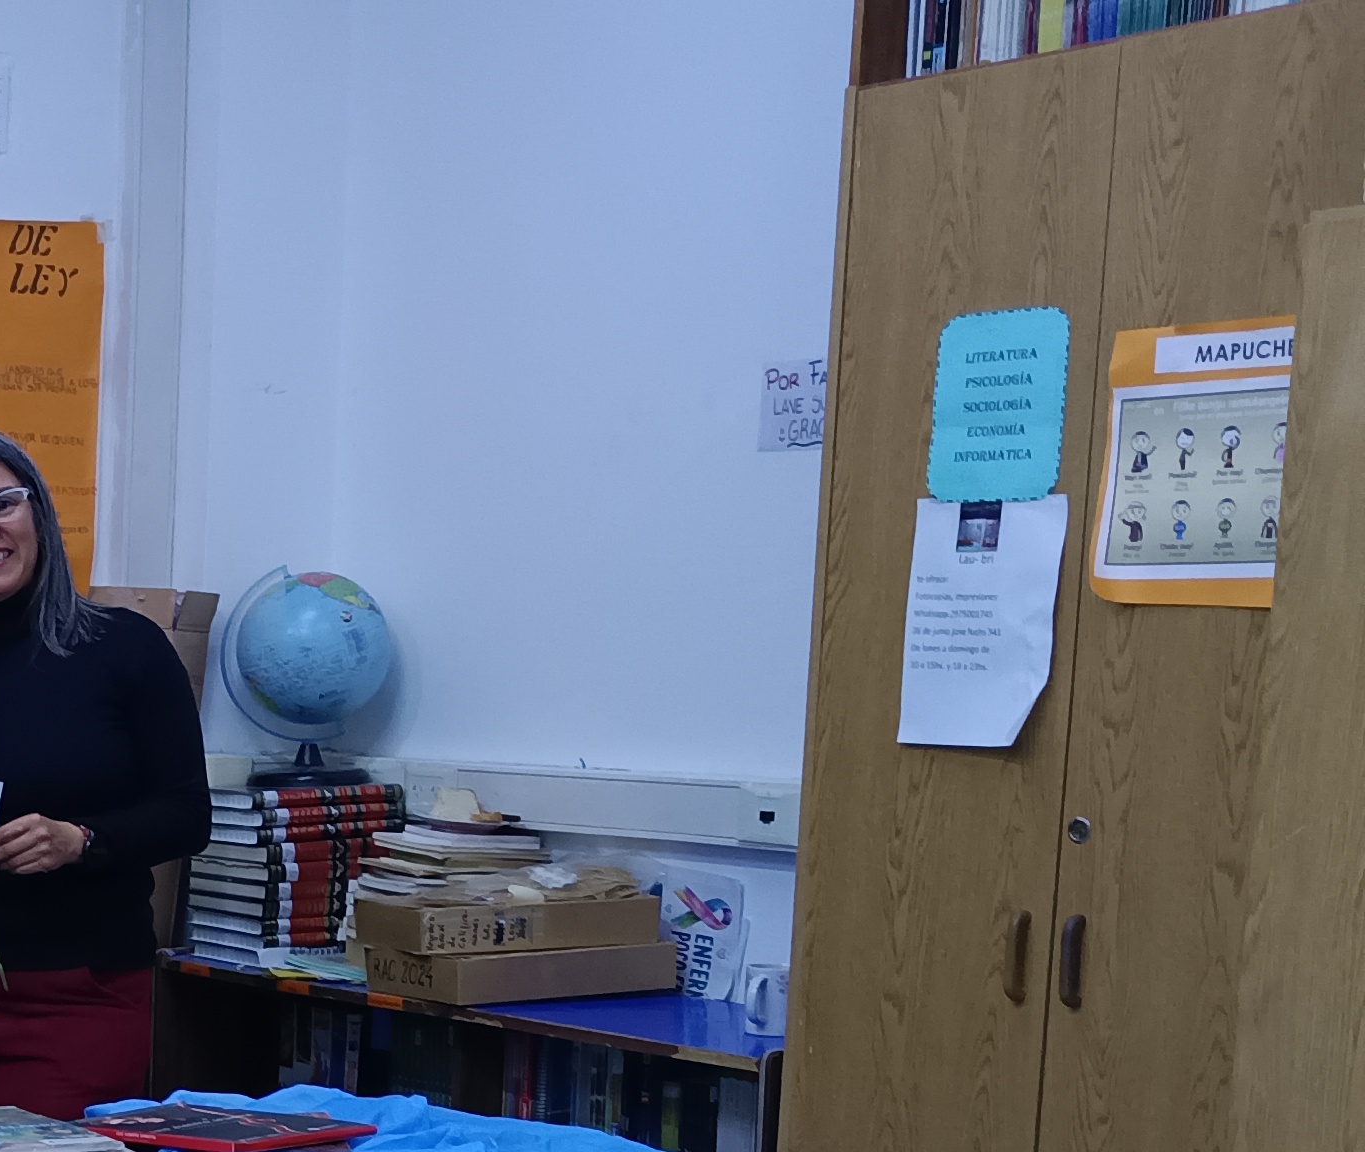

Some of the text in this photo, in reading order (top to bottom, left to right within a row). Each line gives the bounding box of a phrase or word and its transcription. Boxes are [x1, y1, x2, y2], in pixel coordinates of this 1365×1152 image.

[8, 223, 59, 257] DE
[9, 262, 80, 298] LEY
[965, 347, 1038, 364] LITERATURA
[764, 359, 828, 391] POR FA
[964, 370, 1033, 389] PSICOLOGÍA
[772, 397, 805, 416] LAVE
[962, 396, 1032, 414] SOCIOLOGÍA
[787, 417, 824, 442] GRAC
[966, 422, 1026, 438] ECONOMÍA
